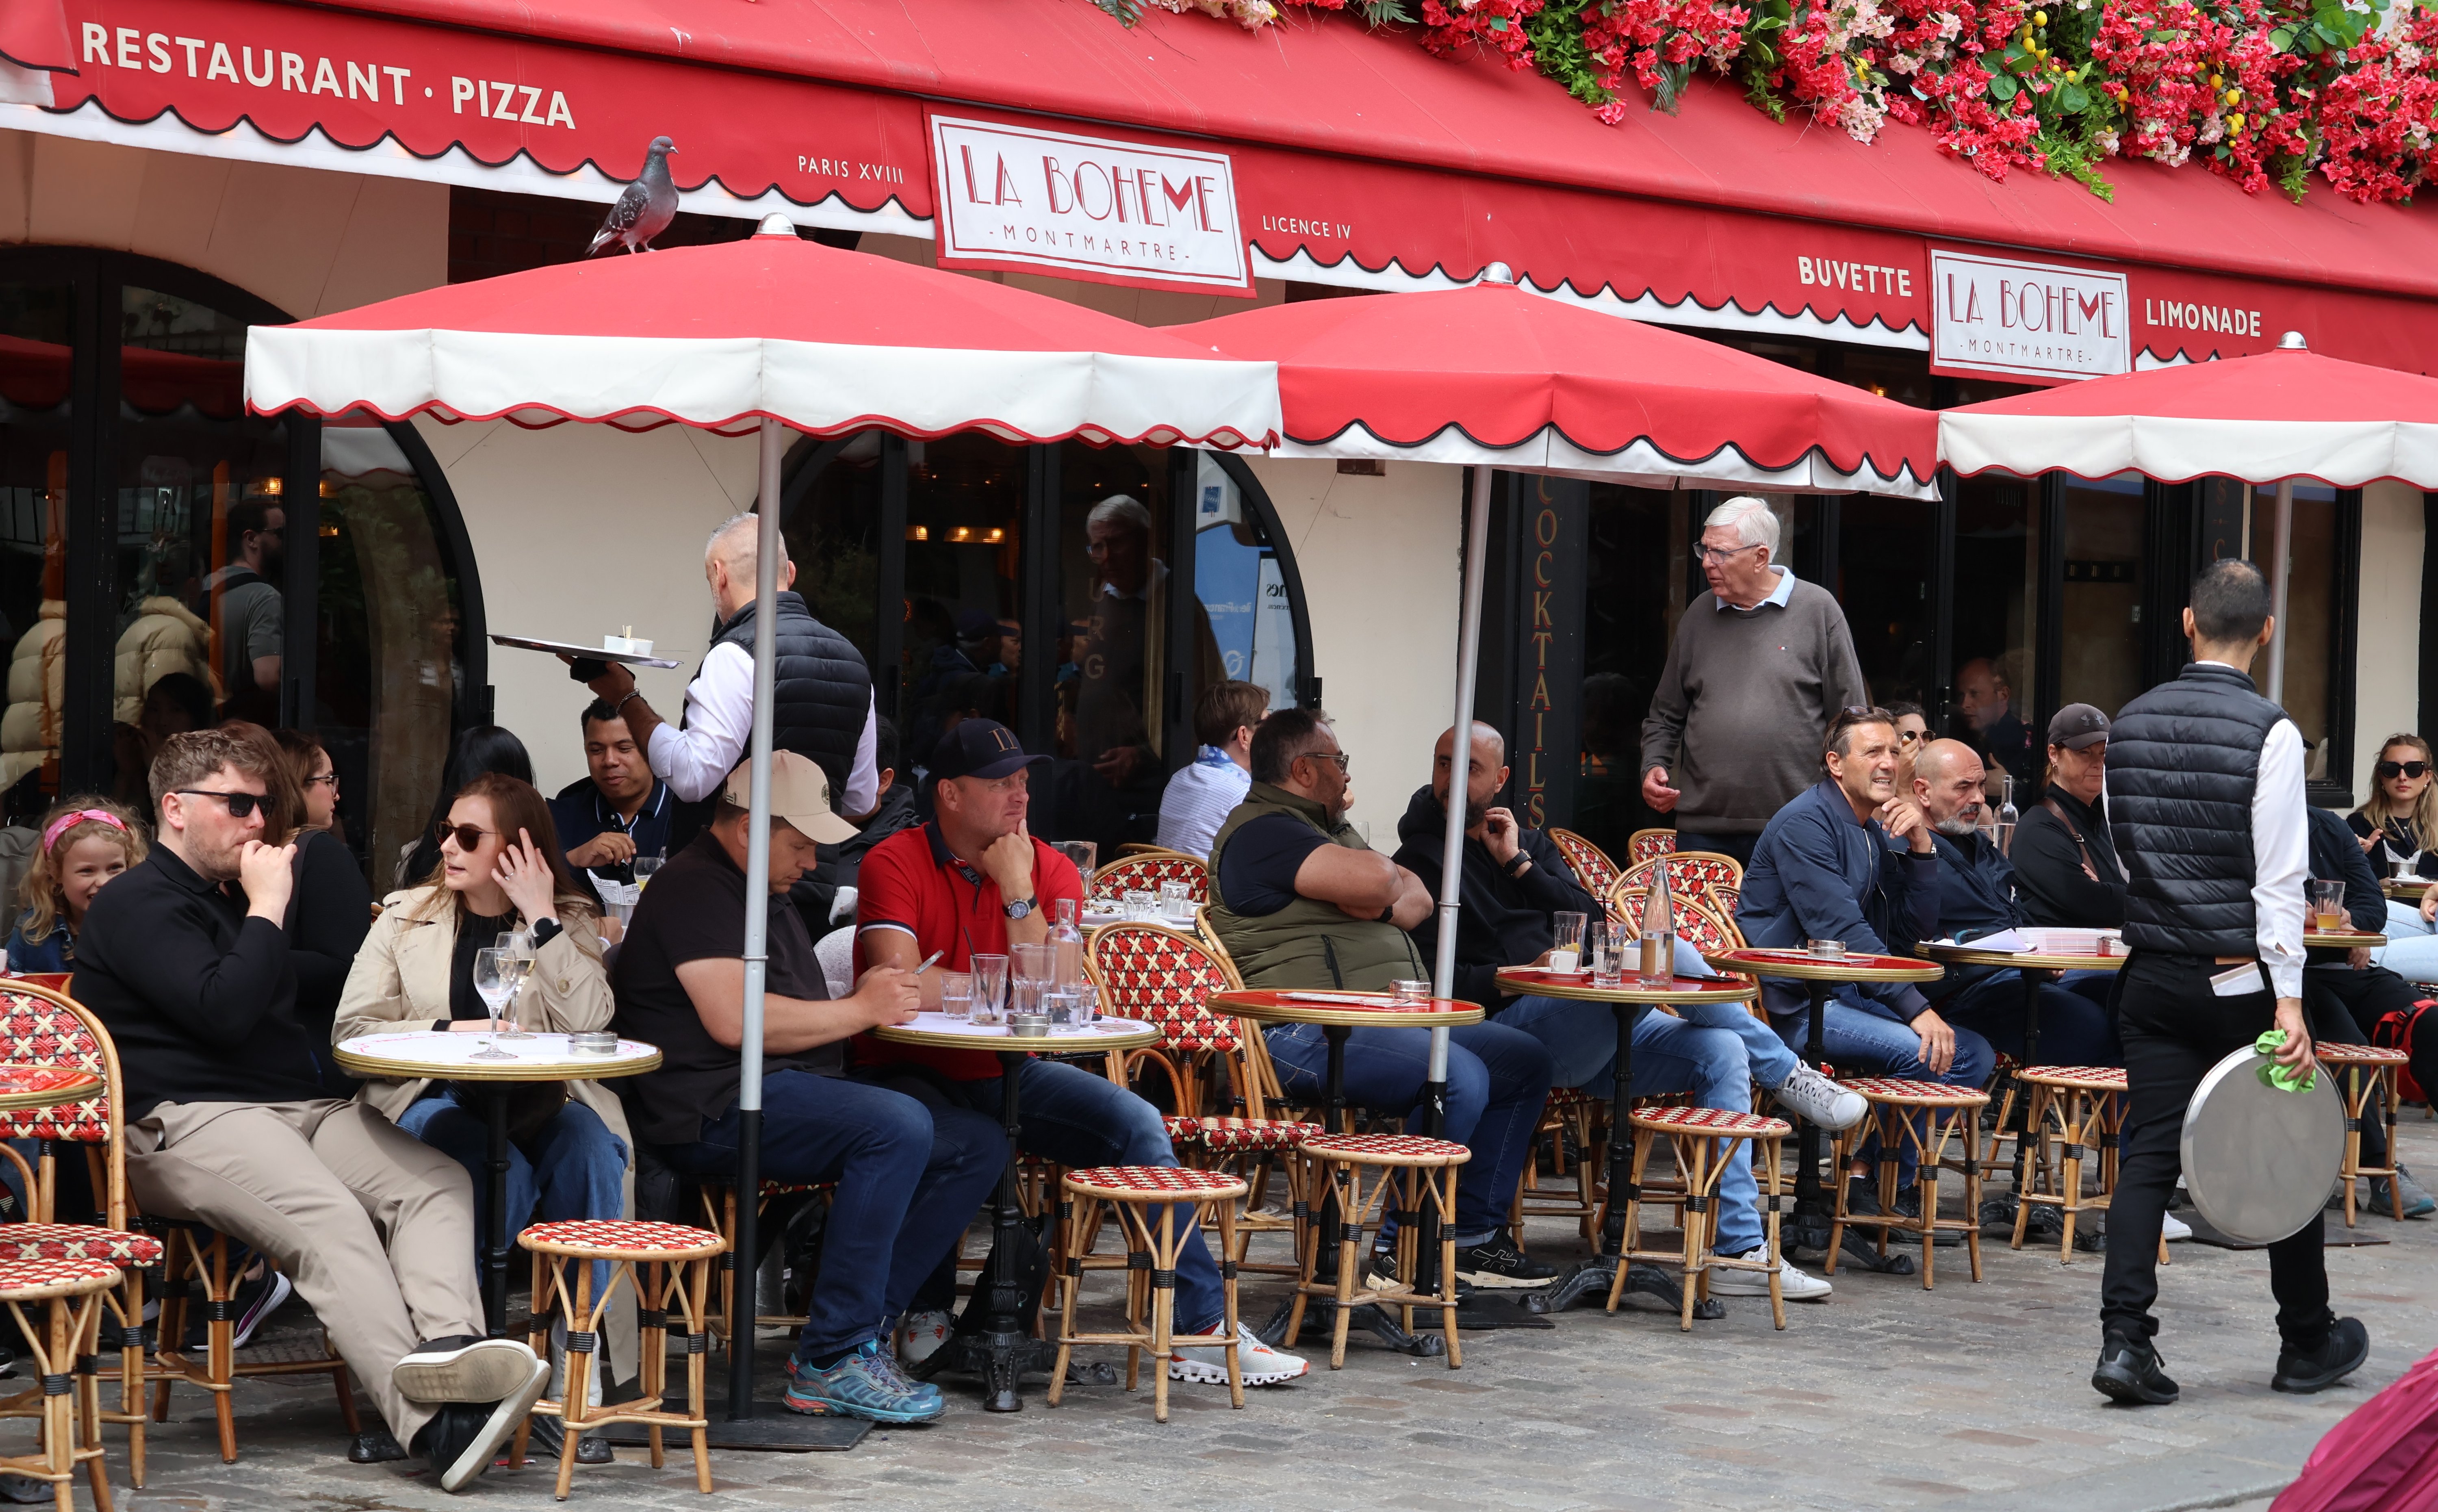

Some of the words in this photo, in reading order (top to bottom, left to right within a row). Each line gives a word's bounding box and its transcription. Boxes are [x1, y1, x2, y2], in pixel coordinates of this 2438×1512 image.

[82, 22, 410, 105] RESTAURANT
[452, 76, 576, 129] PIZZA
[798, 156, 848, 177] PARIS
[859, 163, 903, 184] XVIII
[961, 145, 1022, 206] LA
[1043, 156, 1223, 233] BOHEME
[1263, 215, 1330, 237] LICENCE
[1337, 224, 1350, 239] IV
[1798, 256, 1912, 297] BUVETTE
[1948, 273, 1983, 323] LA
[2000, 280, 2117, 338] BOHEME
[2146, 299, 2260, 337] LIMONADE
[1527, 474, 1557, 830] COCKTAILS
